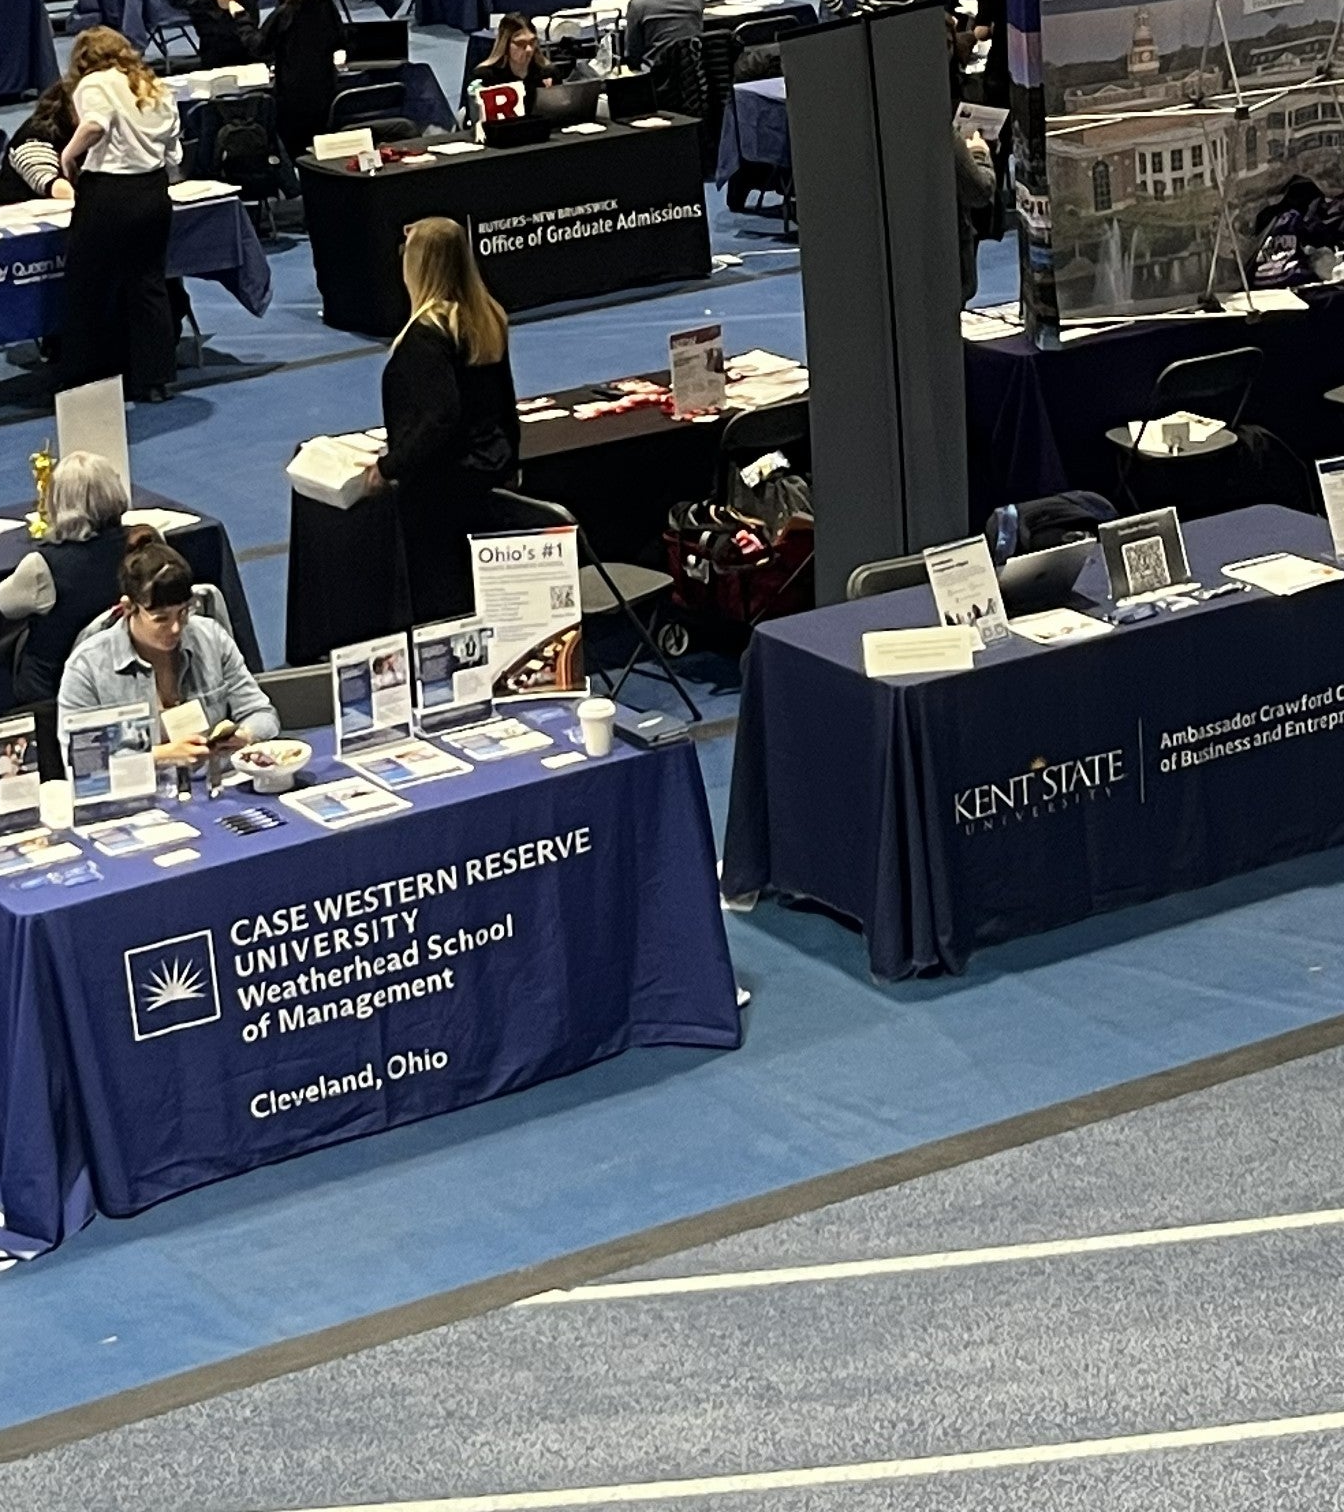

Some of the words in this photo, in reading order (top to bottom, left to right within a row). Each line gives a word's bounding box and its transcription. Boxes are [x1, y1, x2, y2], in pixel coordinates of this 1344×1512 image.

[480, 86, 519, 122] R
[479, 233, 524, 256] Office
[528, 227, 543, 247] of
[546, 218, 613, 243] Graduate
[616, 203, 702, 231] Admissions
[12, 261, 54, 277] Queen
[478, 544, 536, 564] Ohio's
[542, 542, 562, 559] #1
[1160, 710, 1258, 751] Ambassador
[1260, 686, 1333, 723] Crawford
[1160, 755, 1179, 774] of
[1181, 736, 1252, 769] Business
[1253, 725, 1282, 748] and
[955, 772, 1035, 825] KENT
[1041, 749, 1127, 799] STATE
[964, 786, 1114, 837] UNIVERSITY
[230, 903, 310, 947] CASE
[314, 865, 458, 922] WESTERN
[465, 827, 593, 886] RESERVE
[234, 908, 420, 978] UNIVERSITY
[238, 939, 420, 1012] Weatherhead
[427, 913, 515, 957] School
[242, 1015, 270, 1043] of
[278, 967, 455, 1035] Management
[250, 1063, 383, 1119] Cleveland,
[387, 1050, 449, 1080] Ohio
